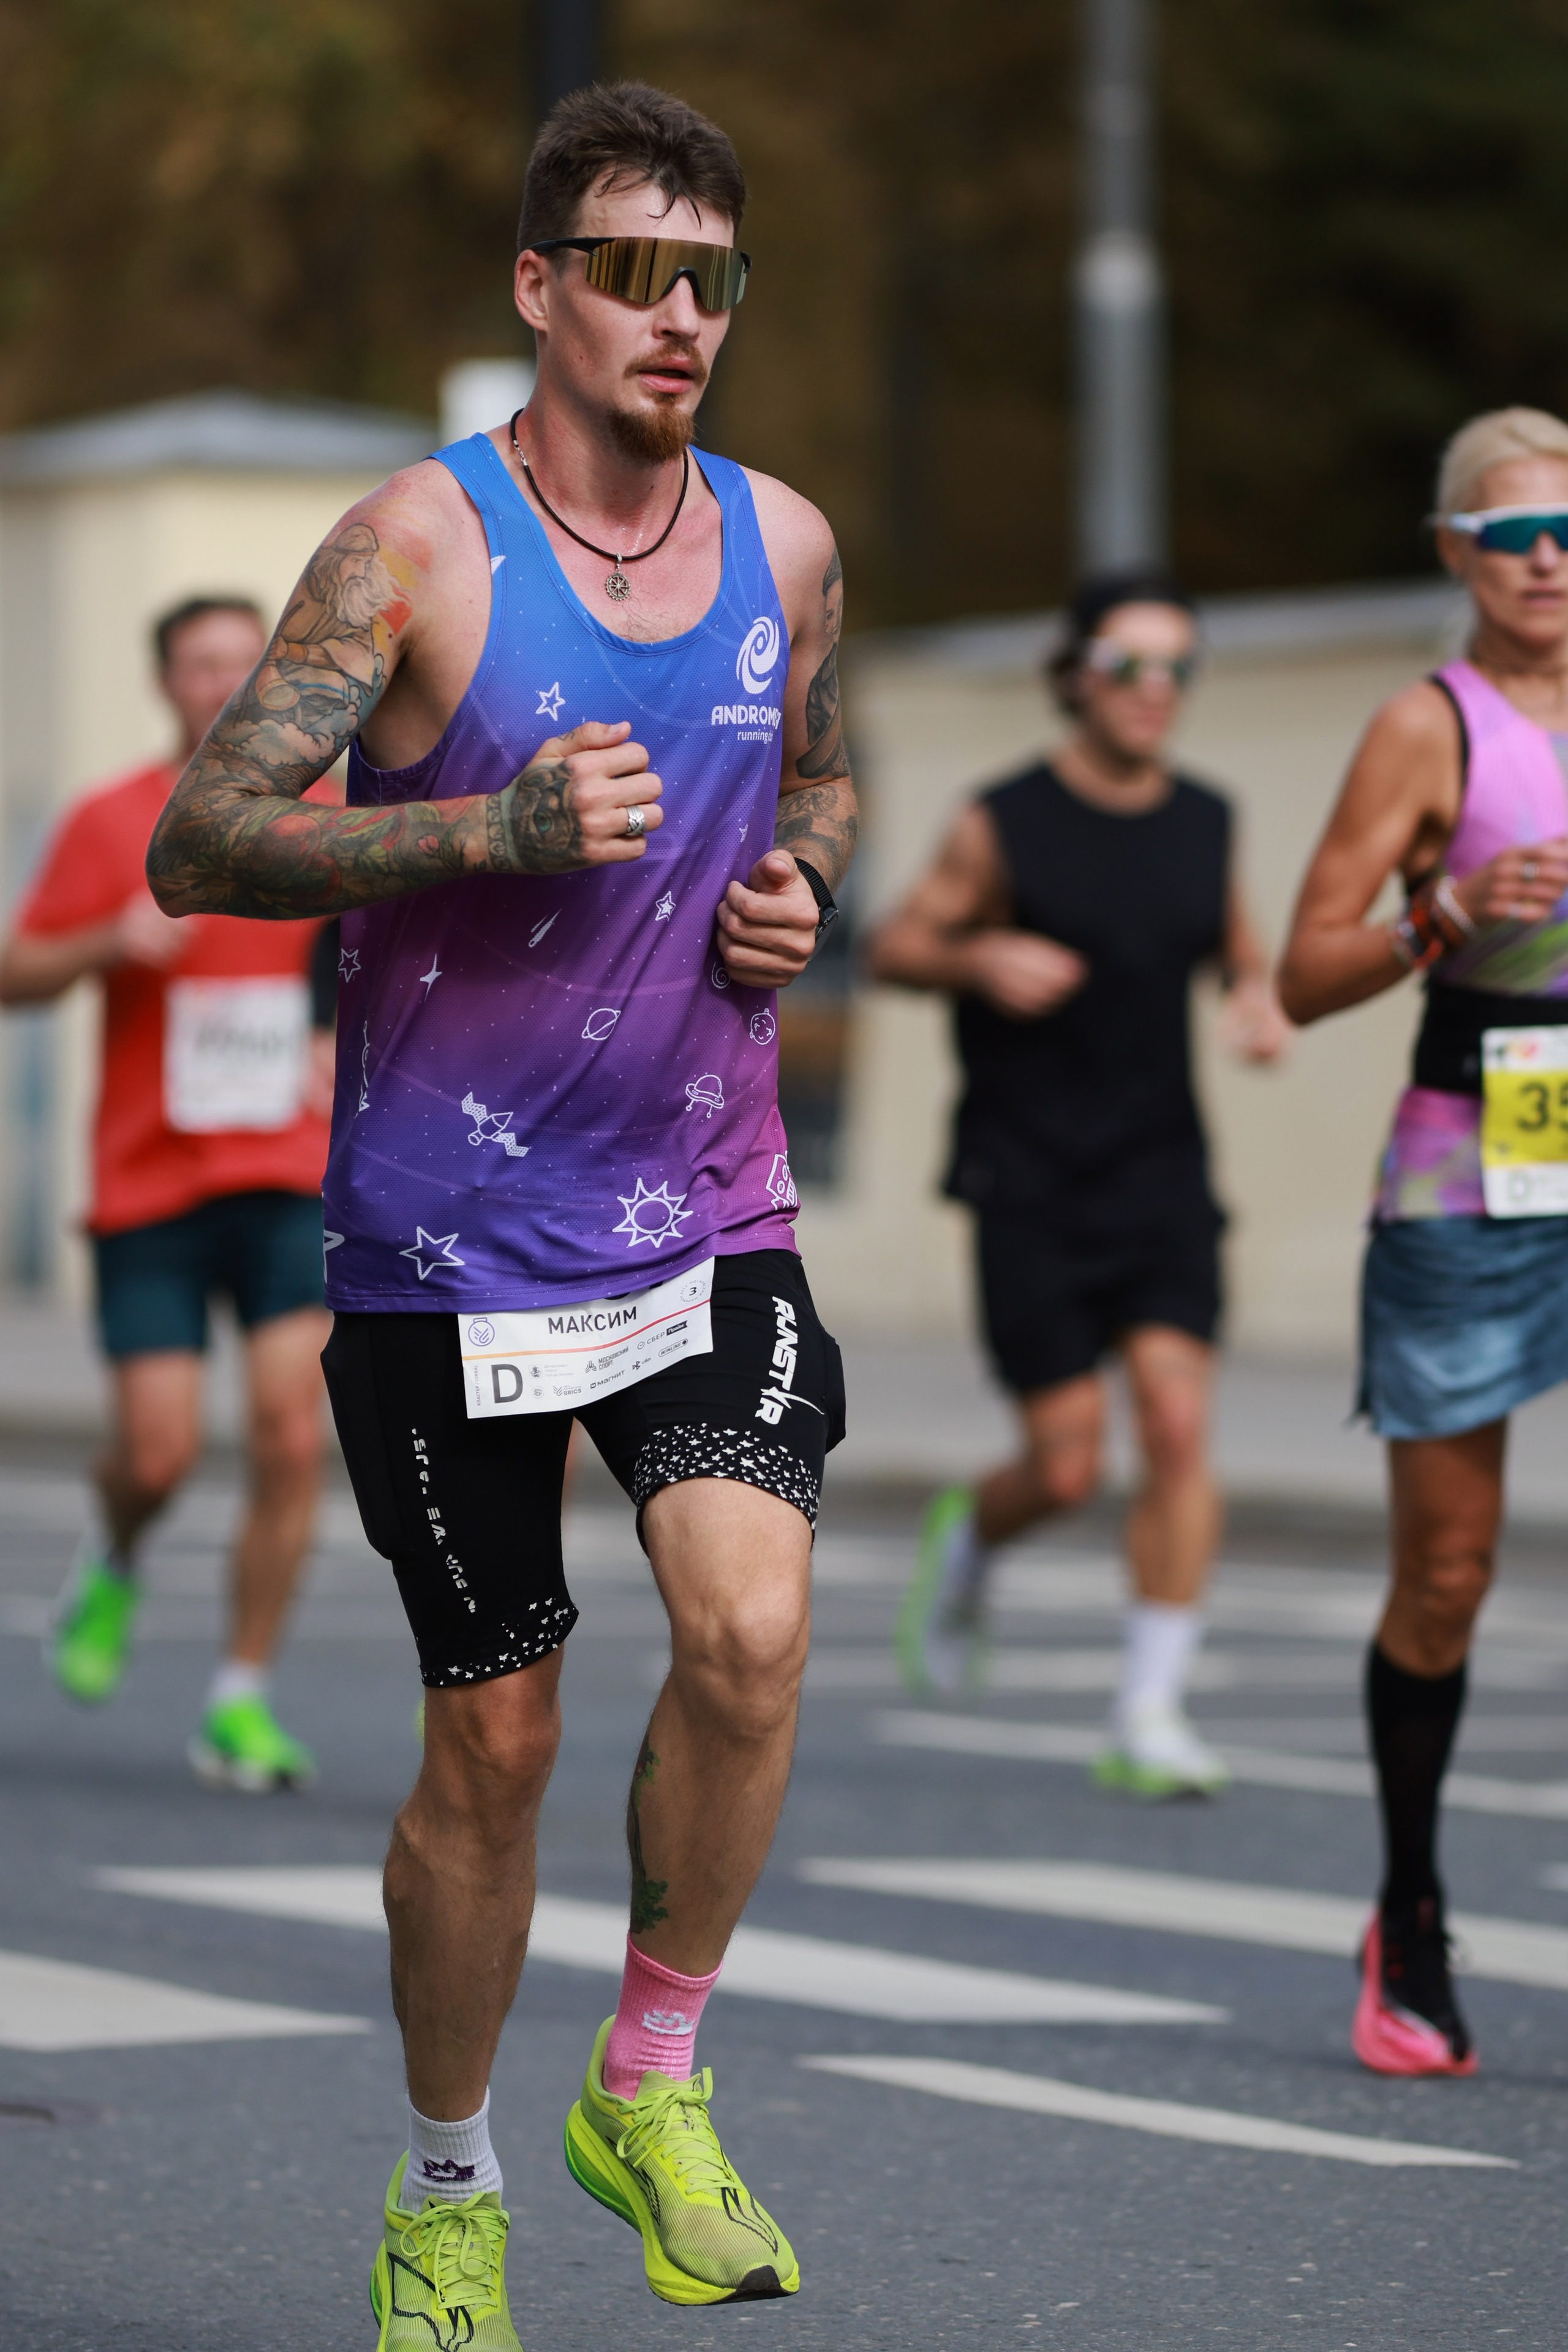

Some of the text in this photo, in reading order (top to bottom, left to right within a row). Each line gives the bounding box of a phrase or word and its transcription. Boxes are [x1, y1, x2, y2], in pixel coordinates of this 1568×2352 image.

[737, 729, 768, 744] running
[689, 1287, 697, 1296] 3
[548, 1306, 636, 1335] МАКСИМ
[647, 1323, 684, 1344] СБЕР Прайм
[598, 1346, 629, 1364] МОСКОВСКИЙ
[660, 1342, 681, 1355] WINLINE
[598, 1360, 613, 1370] СПОРТ
[491, 1363, 524, 1404] D
